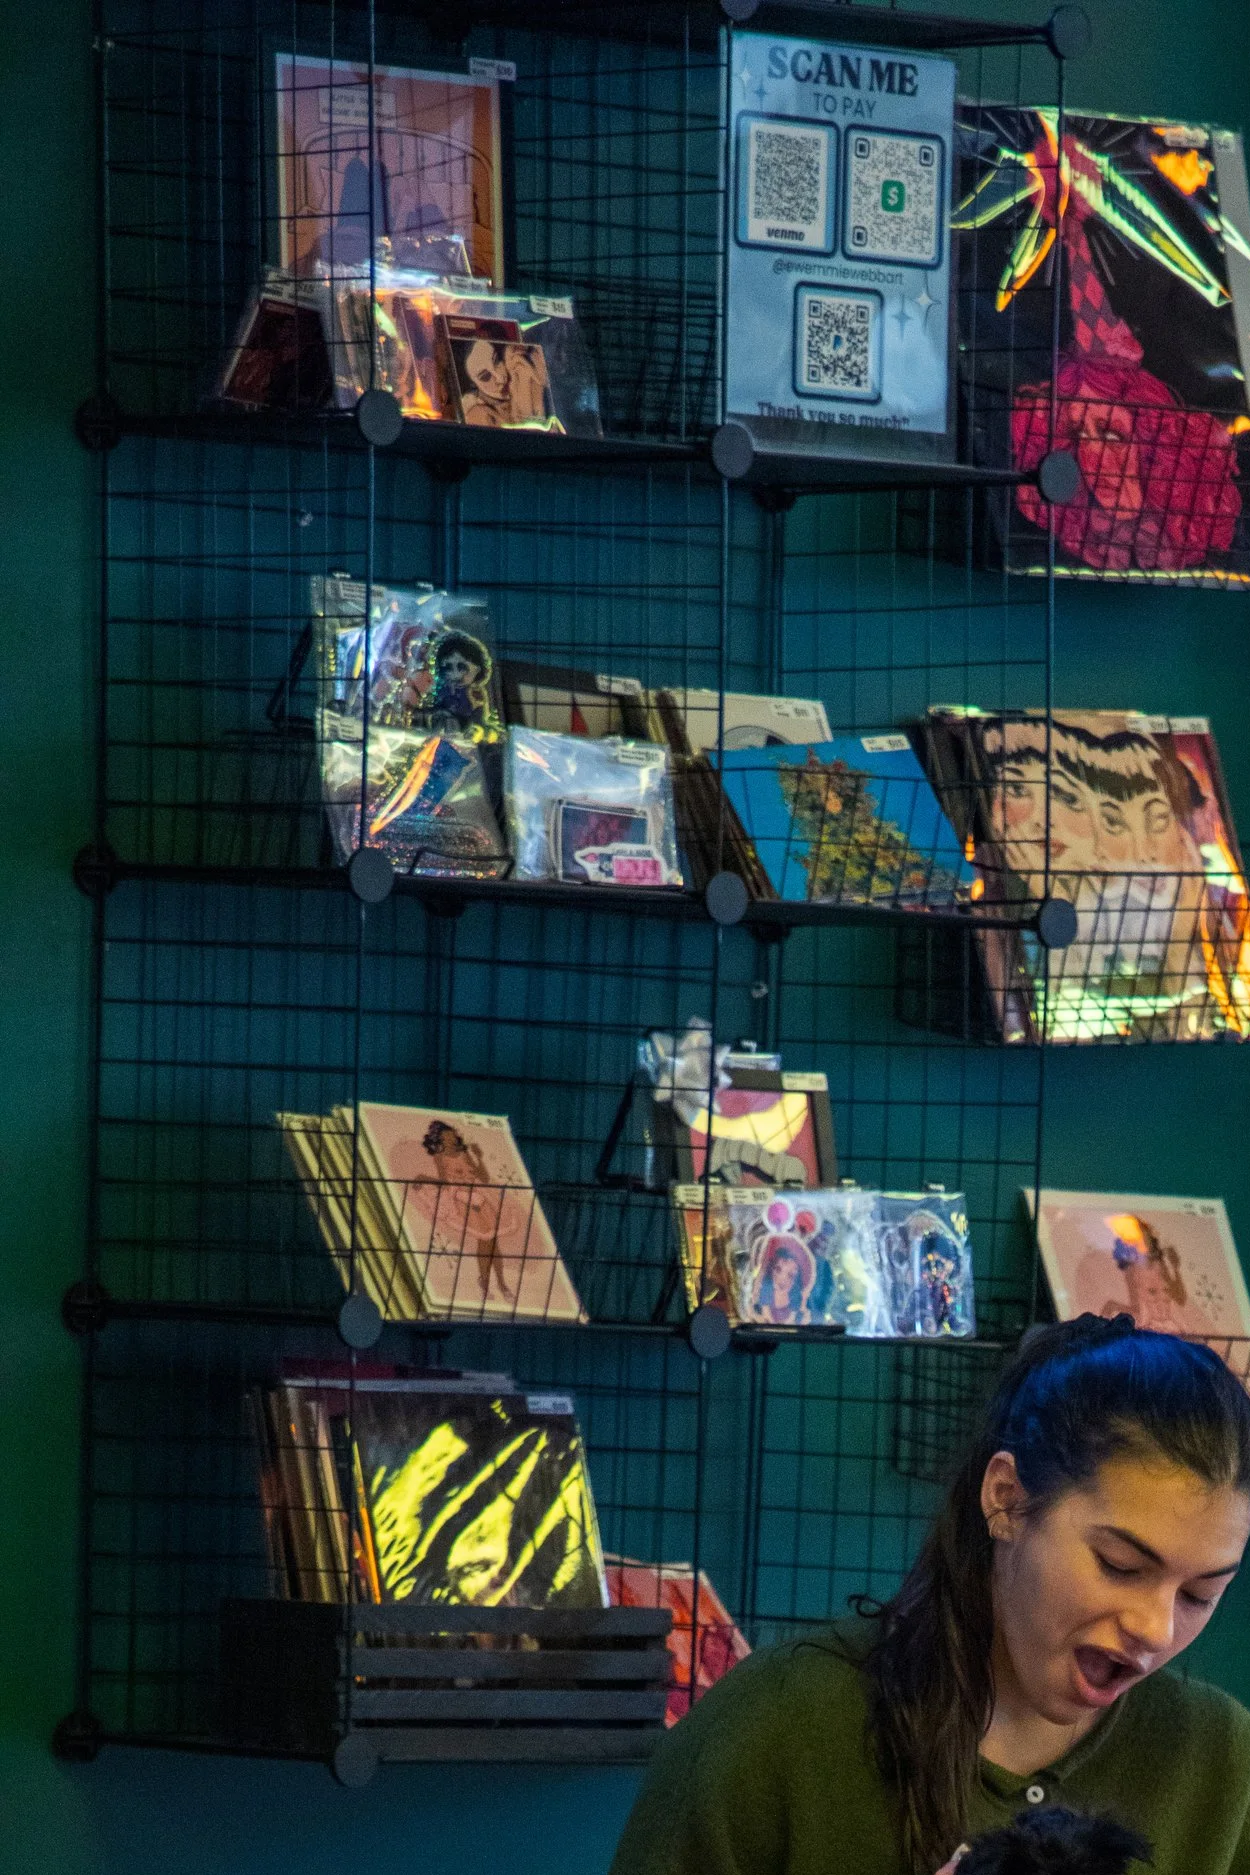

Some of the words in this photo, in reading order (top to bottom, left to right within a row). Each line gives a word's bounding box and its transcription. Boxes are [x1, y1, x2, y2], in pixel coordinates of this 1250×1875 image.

[766, 45, 861, 91] SCAN
[868, 58, 919, 98] ME
[814, 92, 837, 114] TO
[843, 97, 877, 118] PAY
[766, 226, 805, 242] venmo
[772, 257, 904, 286] @ewemmiewebbart
[757, 401, 804, 421] Thank
[807, 410, 836, 424] you
